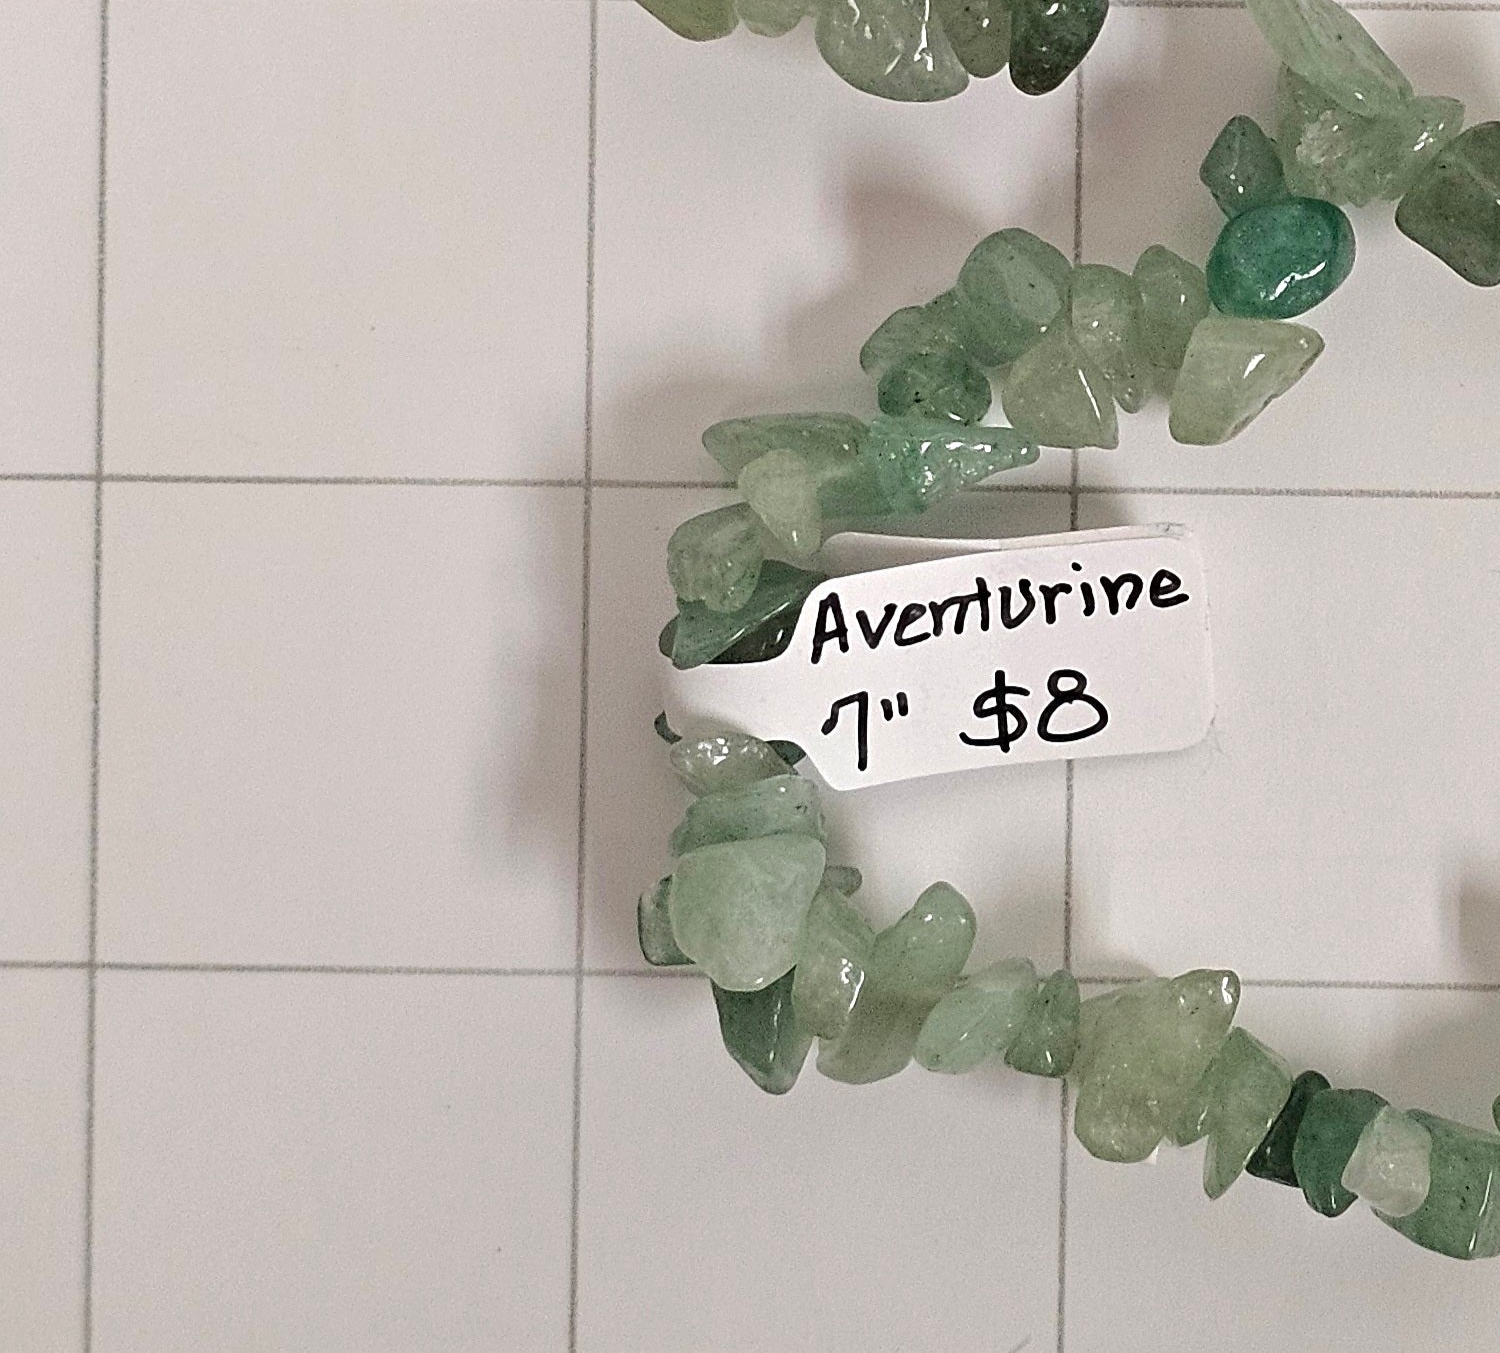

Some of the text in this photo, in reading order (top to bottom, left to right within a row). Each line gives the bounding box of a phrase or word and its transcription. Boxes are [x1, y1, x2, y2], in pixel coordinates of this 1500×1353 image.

[809, 561, 1191, 666] Aventurine
[819, 668, 1110, 773] 7" $8
